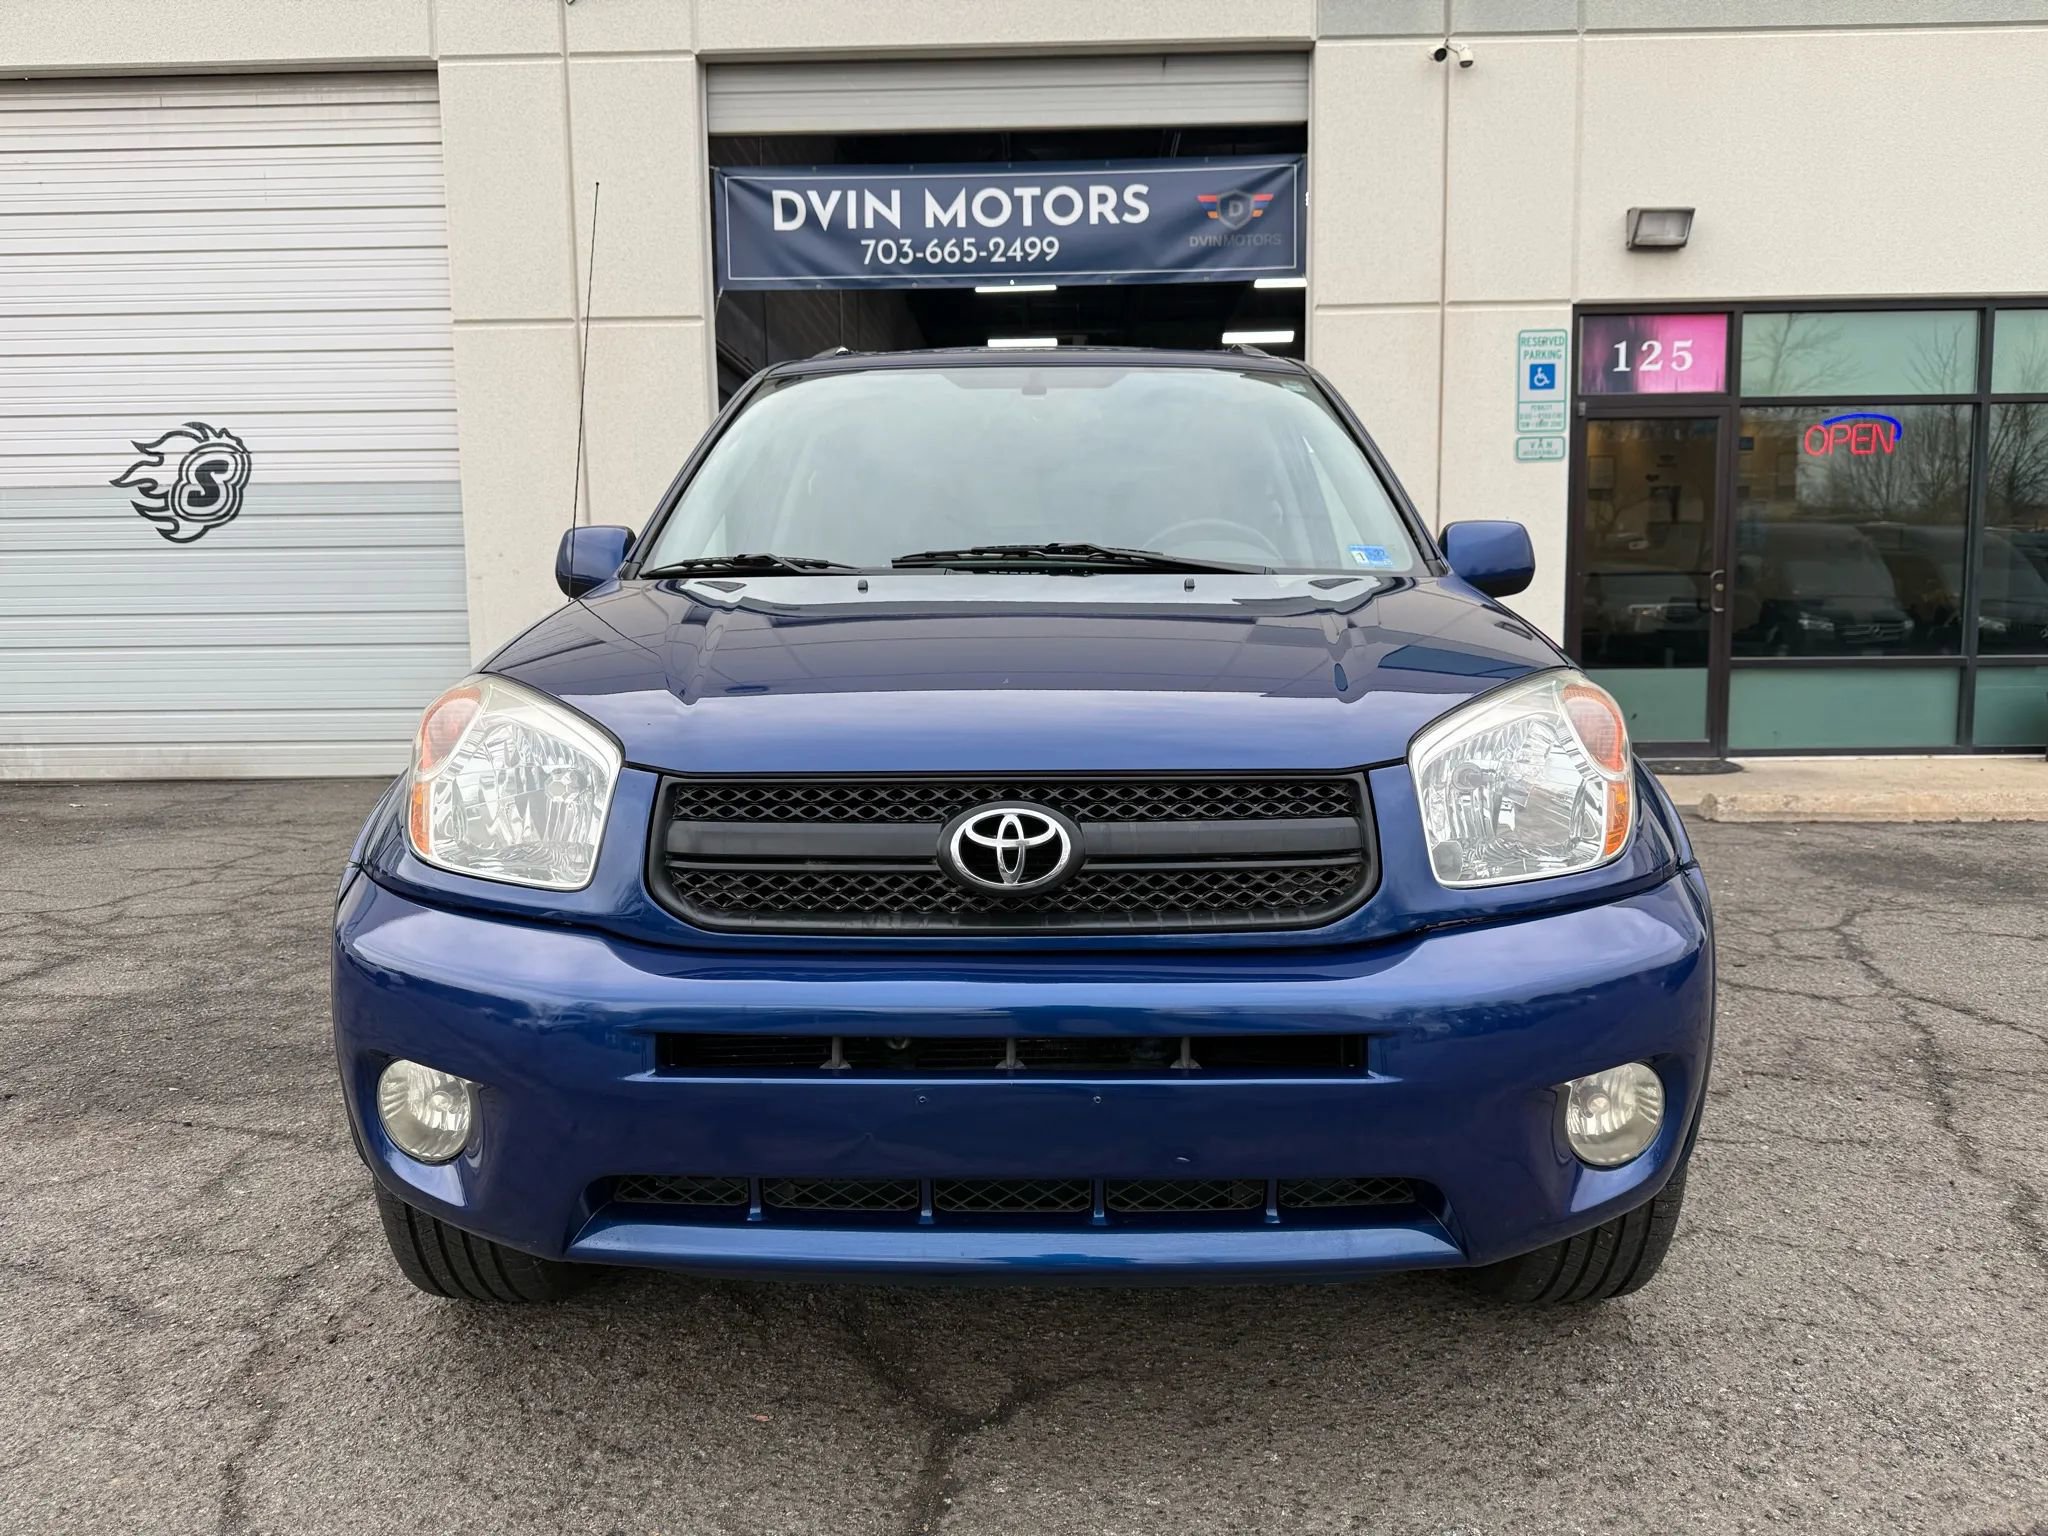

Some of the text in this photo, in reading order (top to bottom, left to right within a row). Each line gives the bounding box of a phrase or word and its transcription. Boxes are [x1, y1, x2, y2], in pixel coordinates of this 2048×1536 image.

[771, 183, 1151, 232] DVIN MOTORS
[1228, 200, 1244, 217] D
[860, 236, 1060, 265] 703-665-2499
[1520, 336, 1565, 347] RESERVED
[1523, 349, 1562, 360] PARKING
[1612, 339, 1694, 372] 125
[1804, 423, 1896, 457] OPEN
